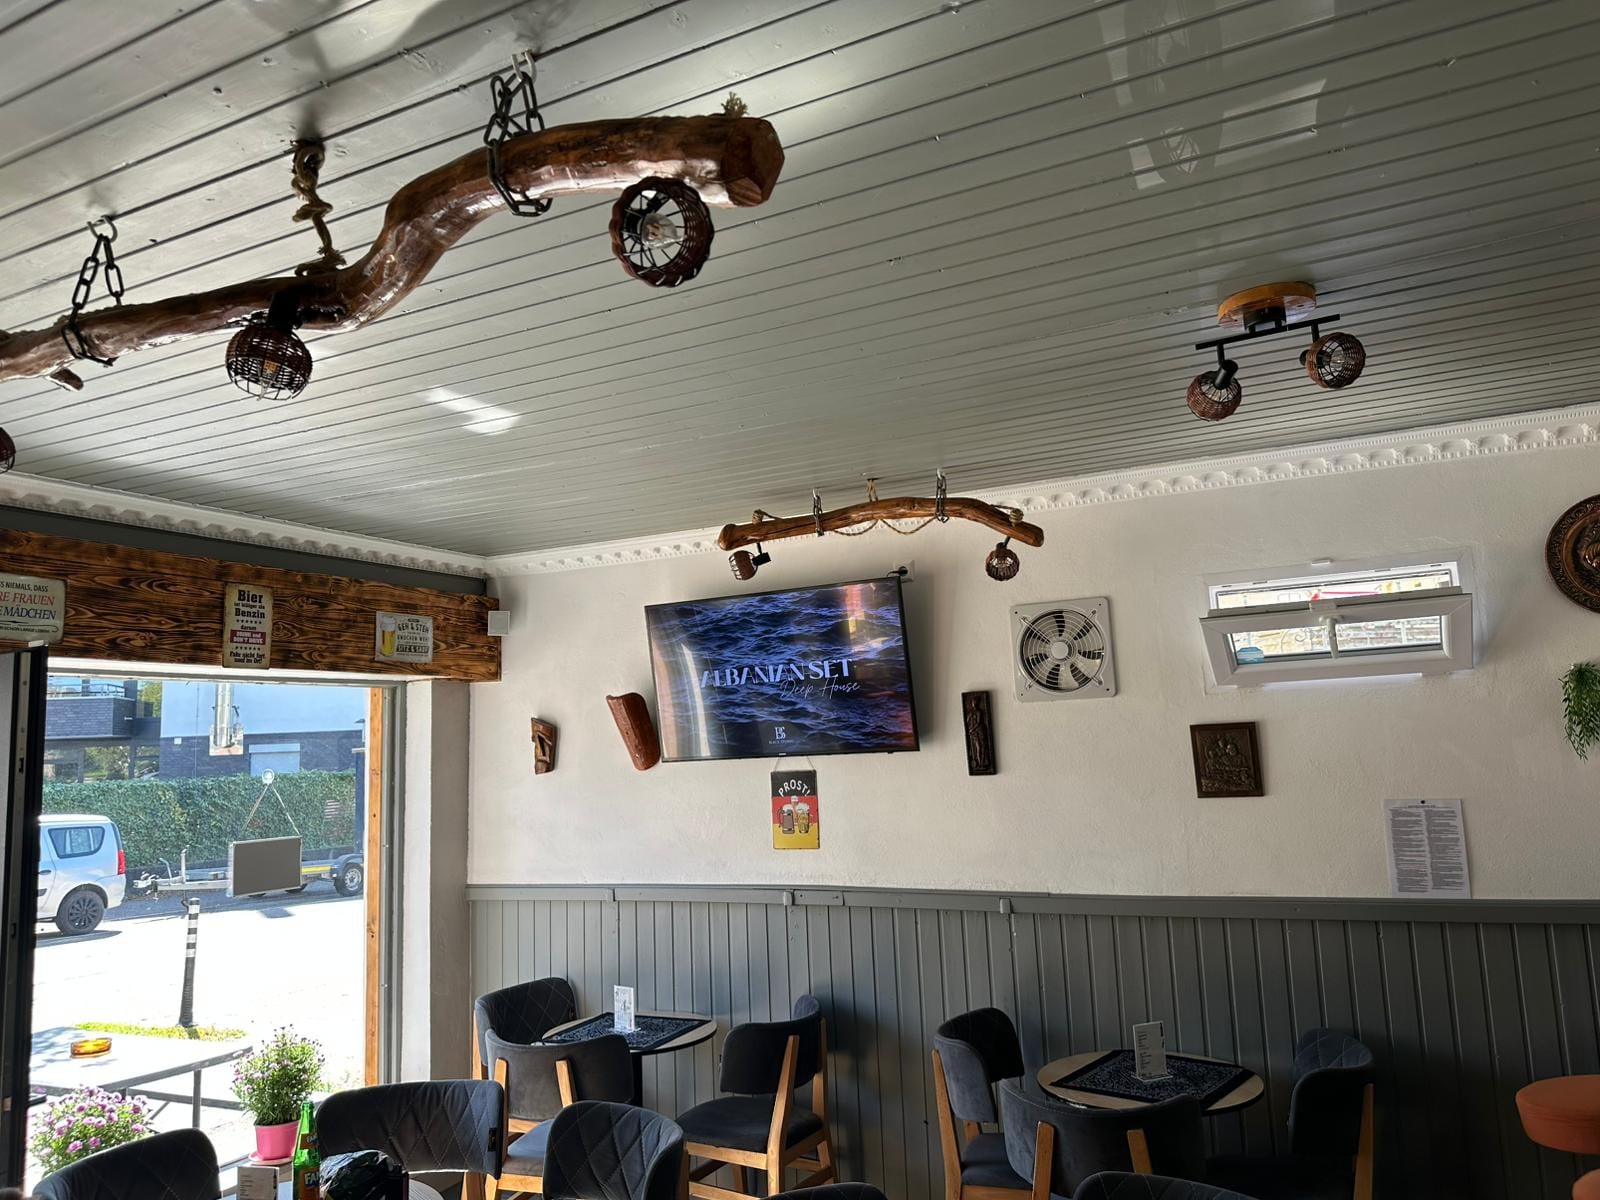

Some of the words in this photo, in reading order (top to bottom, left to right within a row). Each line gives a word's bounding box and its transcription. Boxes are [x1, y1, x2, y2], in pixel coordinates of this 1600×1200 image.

[13, 593, 55, 606] FRAUEN
[237, 590, 263, 604] Bier
[4, 604, 56, 620] MÄDCHEN
[235, 608, 265, 619] Benzin
[701, 663, 805, 688] ALBANIAN
[808, 659, 852, 679] SET
[779, 679, 814, 699] Deep
[821, 677, 861, 700] House
[777, 779, 811, 798] PROST!
